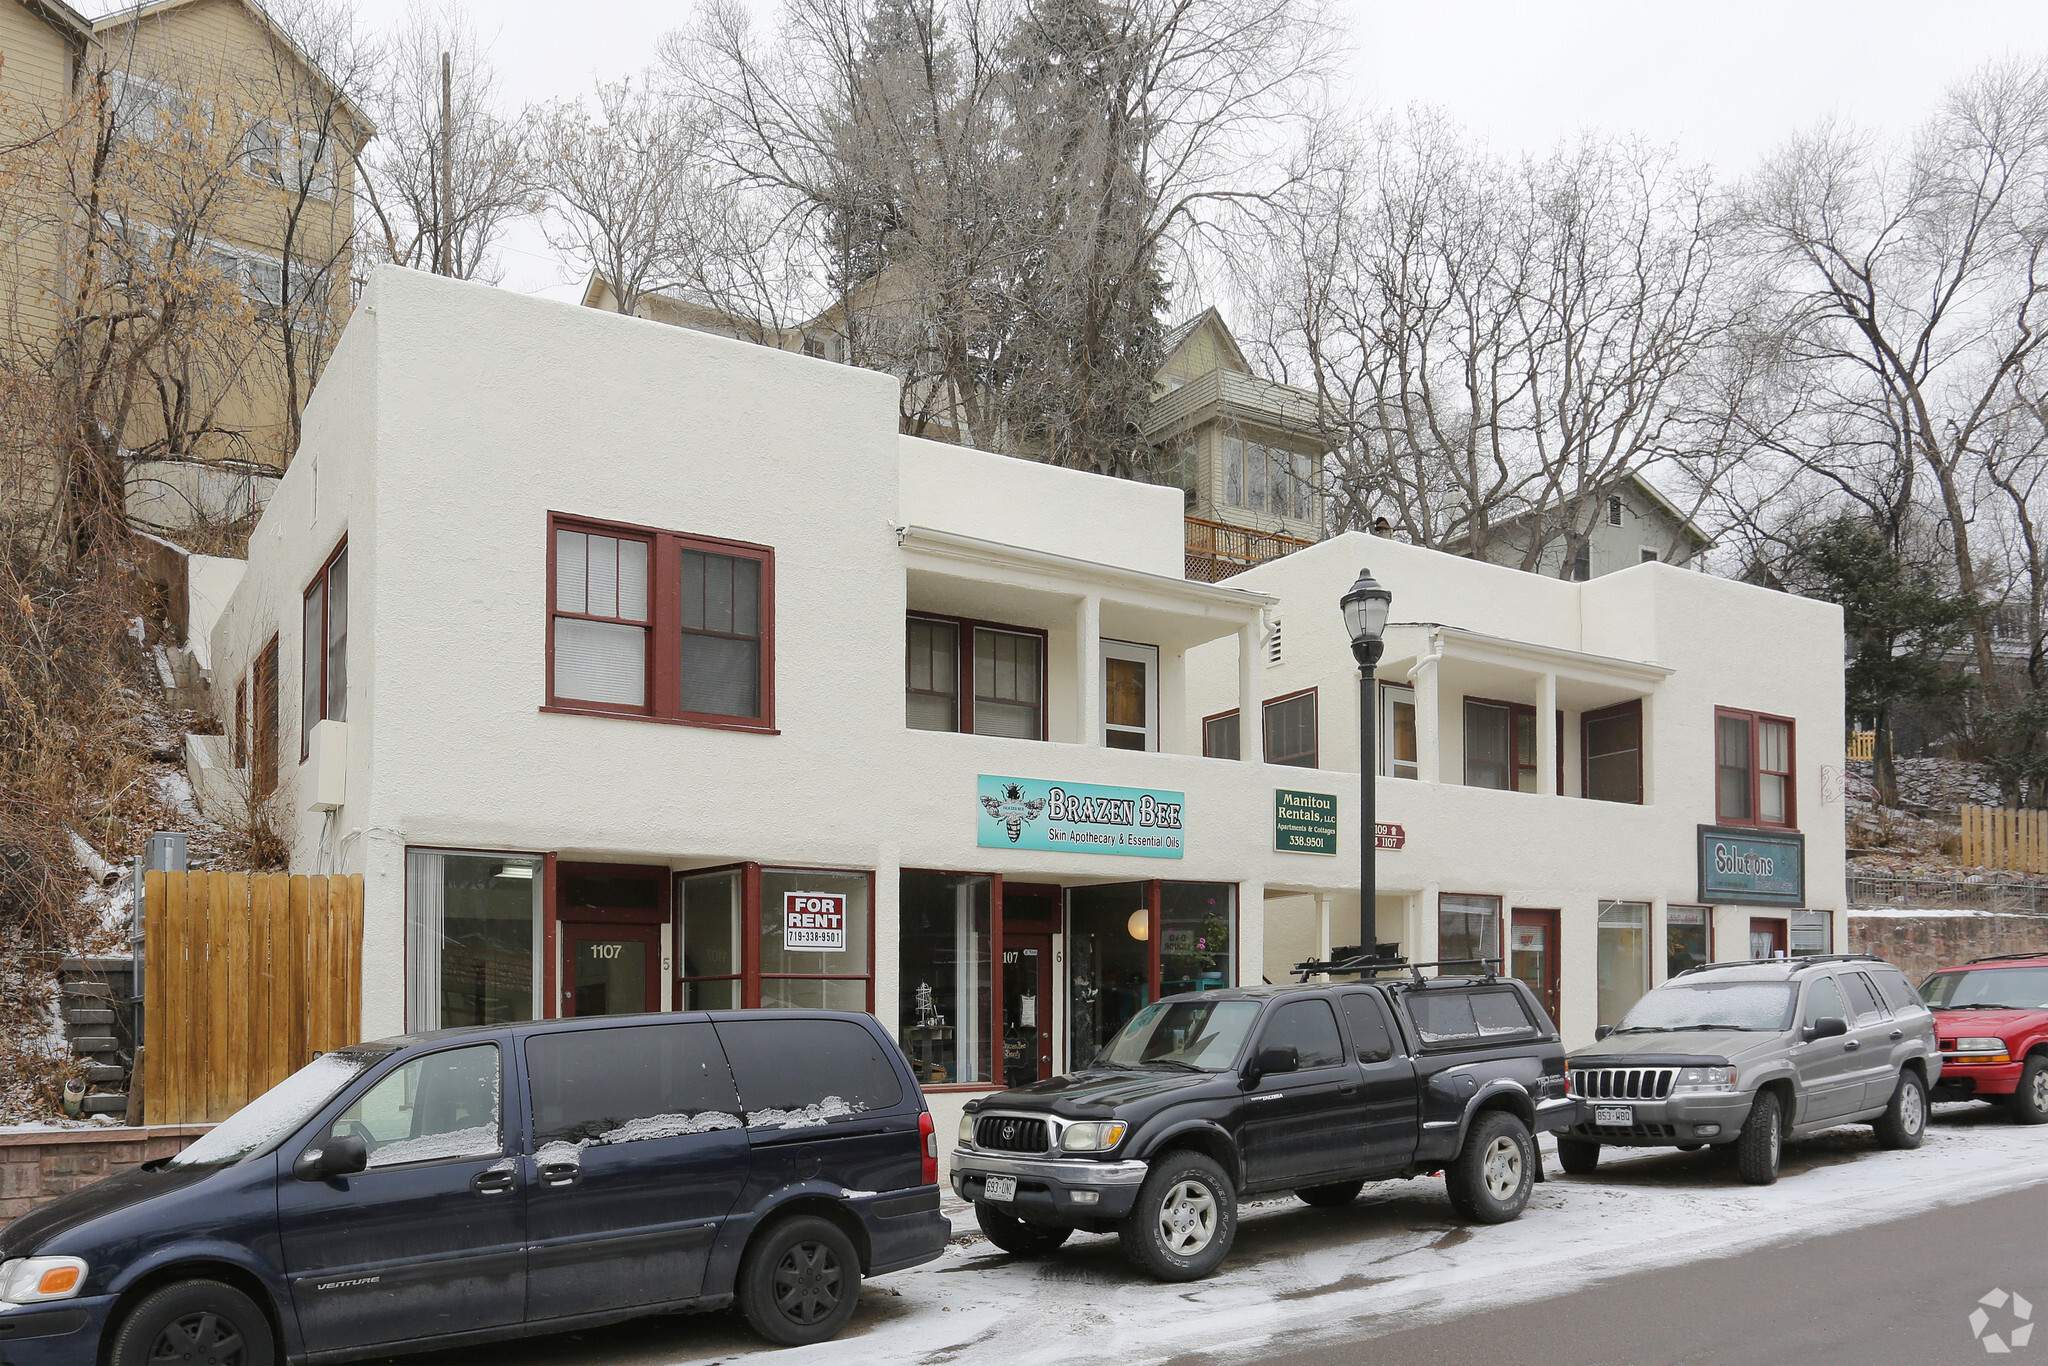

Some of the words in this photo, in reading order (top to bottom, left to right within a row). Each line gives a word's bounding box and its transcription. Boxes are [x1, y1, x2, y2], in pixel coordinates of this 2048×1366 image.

[1048, 787, 1135, 826] BRAZEN
[1139, 795, 1182, 829] BEE
[1283, 793, 1330, 809] Manitou
[1278, 806, 1323, 822] Rentals,
[1324, 815, 1335, 823] LLC
[1277, 823, 1306, 832] Apartments
[1314, 826, 1335, 836] Cottages
[1049, 828, 1066, 841] Skin
[1070, 830, 1115, 846] Apothecary
[1119, 834, 1124, 845] &
[1128, 833, 1163, 847] Essential
[1165, 836, 1180, 848] Oils
[1289, 835, 1324, 848] 338.9501
[1382, 837, 1397, 848] 1107
[795, 898, 835, 913] FOR
[788, 913, 841, 928] RENT
[789, 931, 839, 942] 719-338-9501
[590, 944, 622, 959] 1107
[1056, 951, 1062, 963] 6
[663, 957, 670, 971] 5
[317, 1276, 381, 1290] VENTURE
